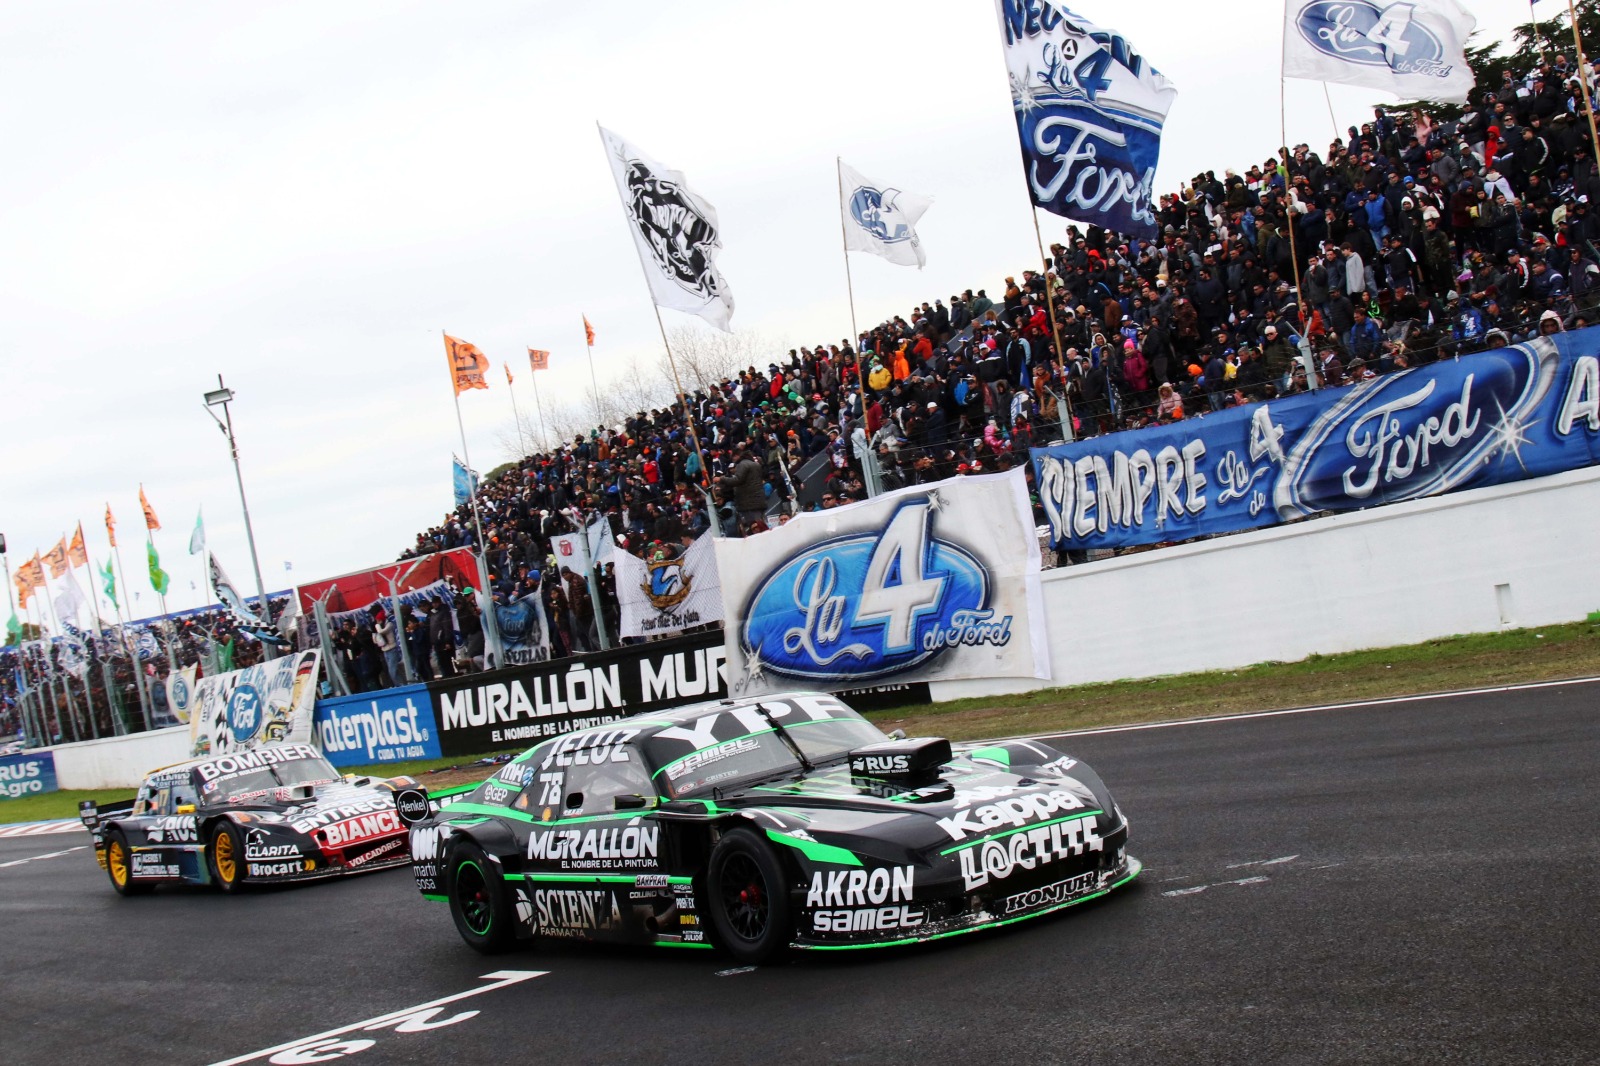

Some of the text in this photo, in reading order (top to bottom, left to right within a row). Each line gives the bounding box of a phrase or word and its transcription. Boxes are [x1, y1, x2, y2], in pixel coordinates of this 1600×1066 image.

[1318, 2, 1415, 66] La 4
[1036, 42, 1086, 98] La
[1073, 47, 1113, 102] 4
[1411, 58, 1453, 78] Ford
[1030, 115, 1158, 226] Ford
[1249, 372, 1481, 517] de Ford
[1039, 404, 1285, 544] SIEMPRE La 4
[784, 500, 946, 666] La 4
[922, 608, 1013, 651] de Ford
[232, 691, 259, 730] Ford
[440, 662, 622, 732] MURALLÓN
[491, 730, 503, 743] EL
[503, 724, 542, 741] NOMBRE
[542, 722, 557, 736] DE
[559, 720, 572, 733] LA
[651, 694, 847, 751] YPF
[406, 744, 426, 758] AGUA
[540, 728, 641, 771] JELUZ
[865, 755, 909, 770] RUS
[399, 800, 427, 813] Henkel
[936, 790, 1086, 841] Kappa
[248, 844, 300, 858] CLARITA
[348, 838, 403, 868] VOLCADORES
[527, 816, 659, 860] MURALLÓN
[252, 860, 304, 877] Brocart
[415, 878, 437, 890] sosa
[561, 859, 659, 869] EL NOMBRE DE LA PINTURA
[806, 865, 915, 908] AKRON
[1005, 871, 1099, 914] KONJUH
[813, 904, 924, 932] samet
